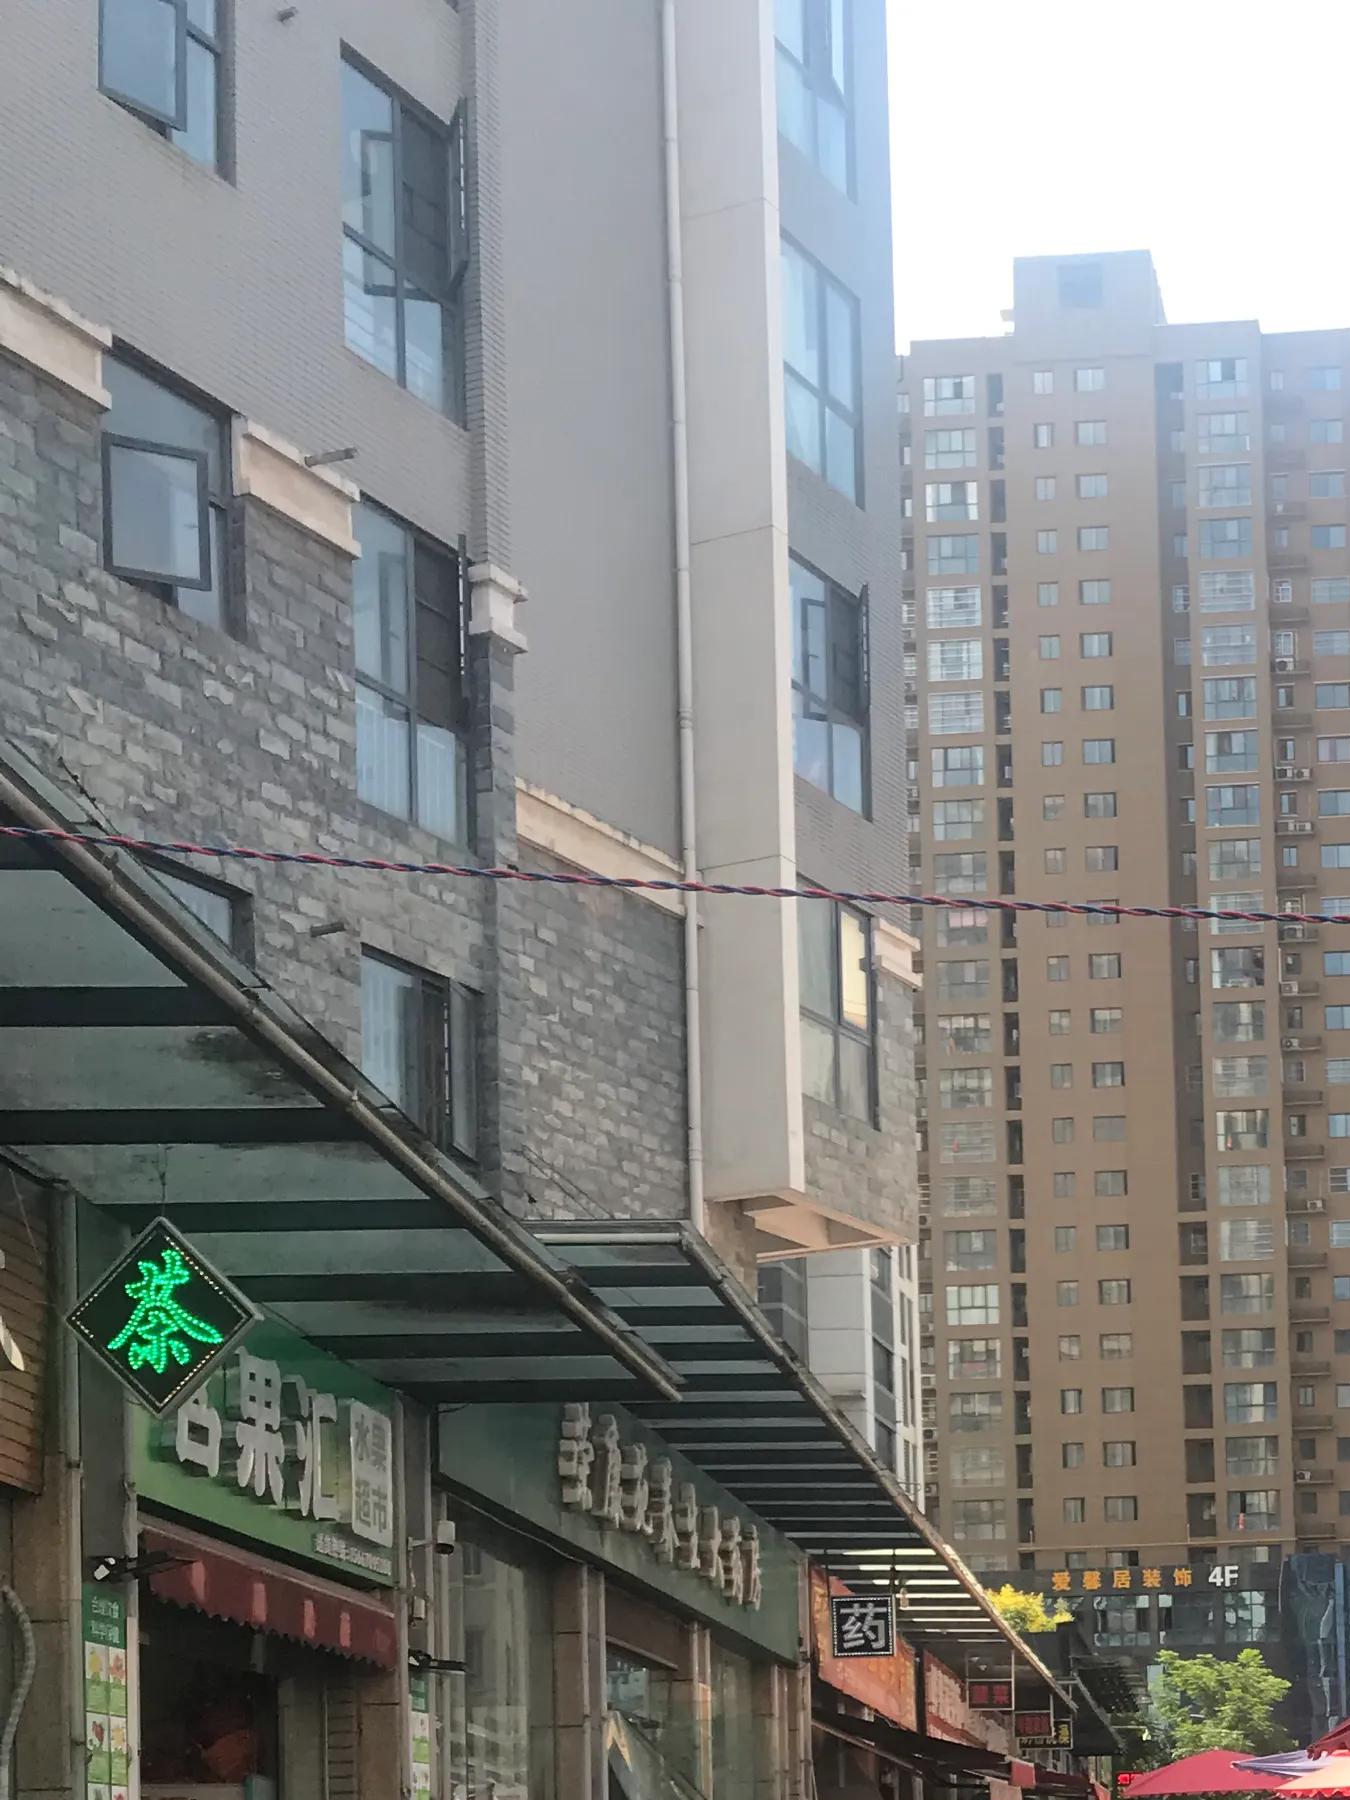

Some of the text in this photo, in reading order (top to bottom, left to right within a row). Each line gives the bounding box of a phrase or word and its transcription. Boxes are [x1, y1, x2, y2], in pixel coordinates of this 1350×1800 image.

[107, 1249, 224, 1374] 茶
[1051, 1565, 1239, 1592] 爱馨居装饰 4F
[839, 1602, 888, 1650] 药
